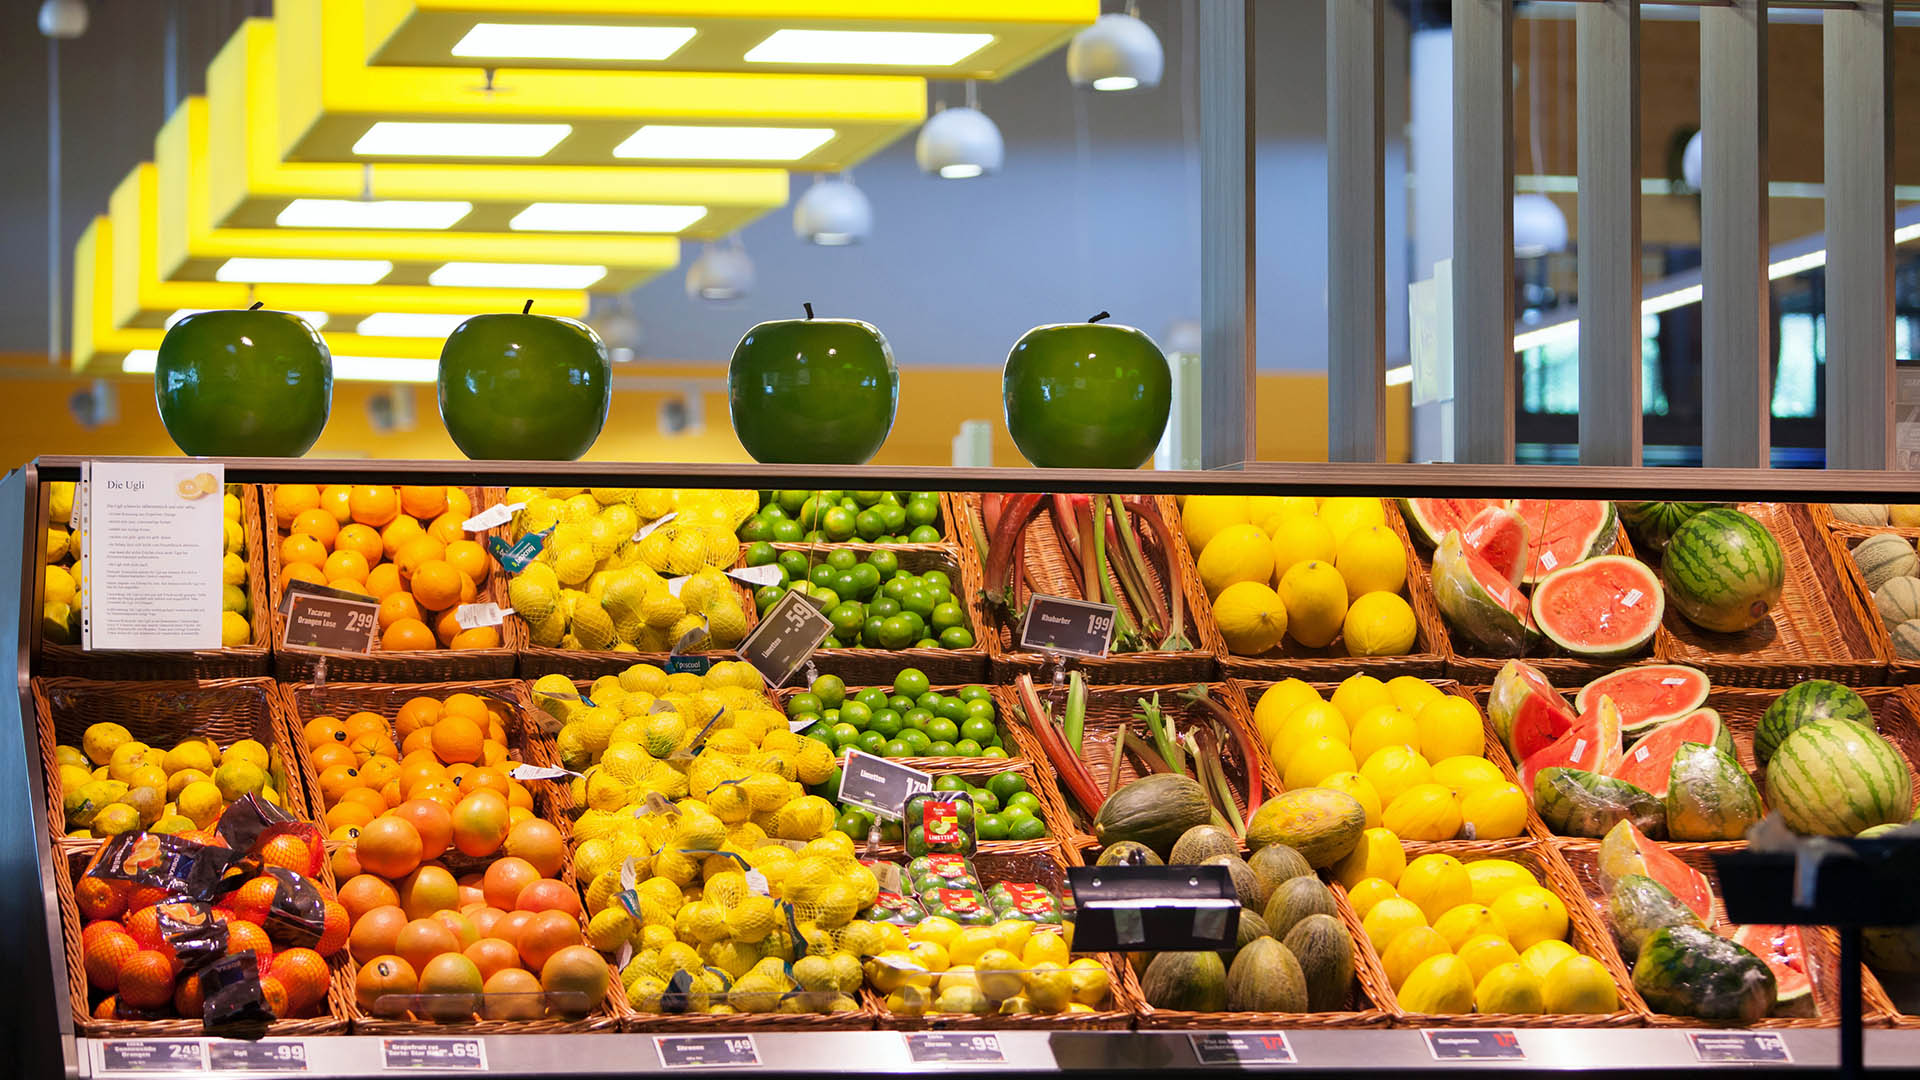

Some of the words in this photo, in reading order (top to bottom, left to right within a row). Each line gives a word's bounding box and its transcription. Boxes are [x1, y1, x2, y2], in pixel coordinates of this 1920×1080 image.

[107, 480, 123, 489] Die
[126, 480, 145, 492] Ugli
[307, 607, 331, 618] Yacaran
[1041, 613, 1072, 625] Rhabarber
[297, 615, 323, 627] Orangen
[322, 618, 337, 628] Lose
[344, 610, 374, 633] 2.99
[1087, 614, 1110, 635] 1.99
[761, 637, 783, 659] Limetten
[860, 769, 886, 784] Limetten
